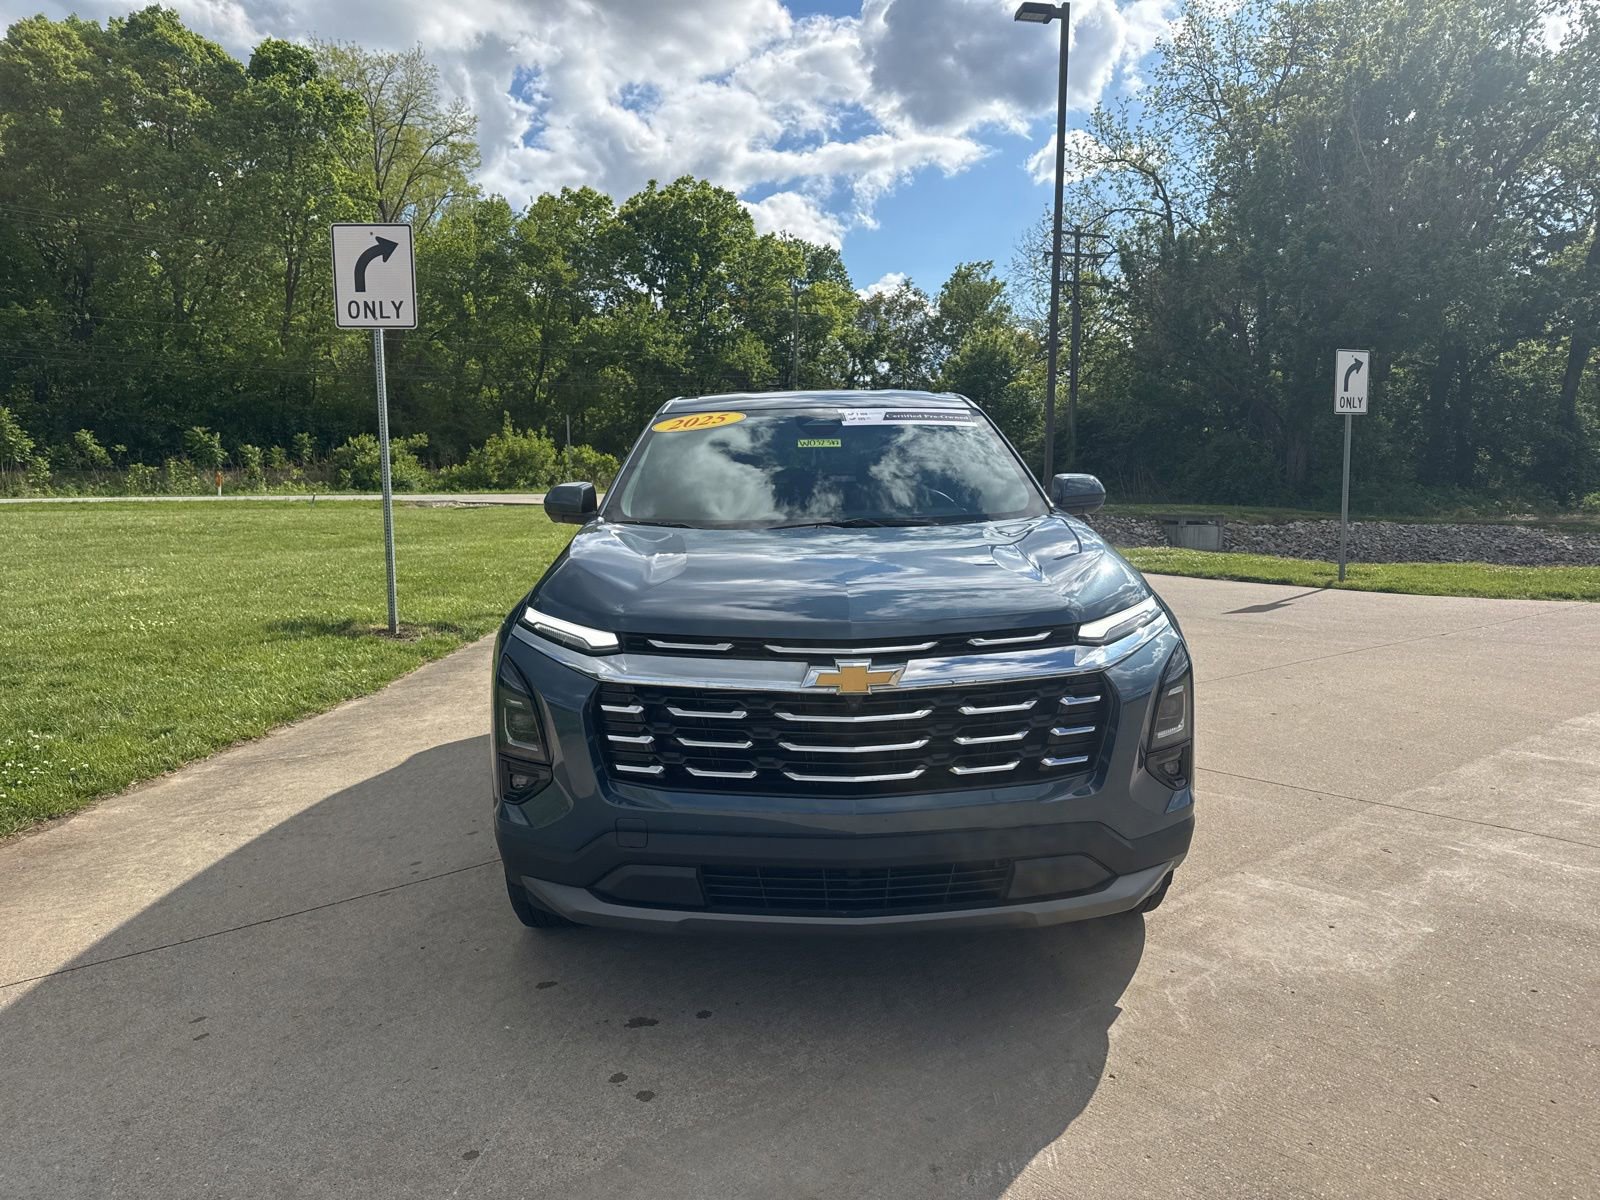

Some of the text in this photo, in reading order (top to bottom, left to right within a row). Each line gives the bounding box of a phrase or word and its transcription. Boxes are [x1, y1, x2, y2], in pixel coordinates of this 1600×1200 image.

[347, 300, 403, 319] ONLY
[1340, 396, 1363, 409] ONLY
[667, 413, 729, 430] 2025
